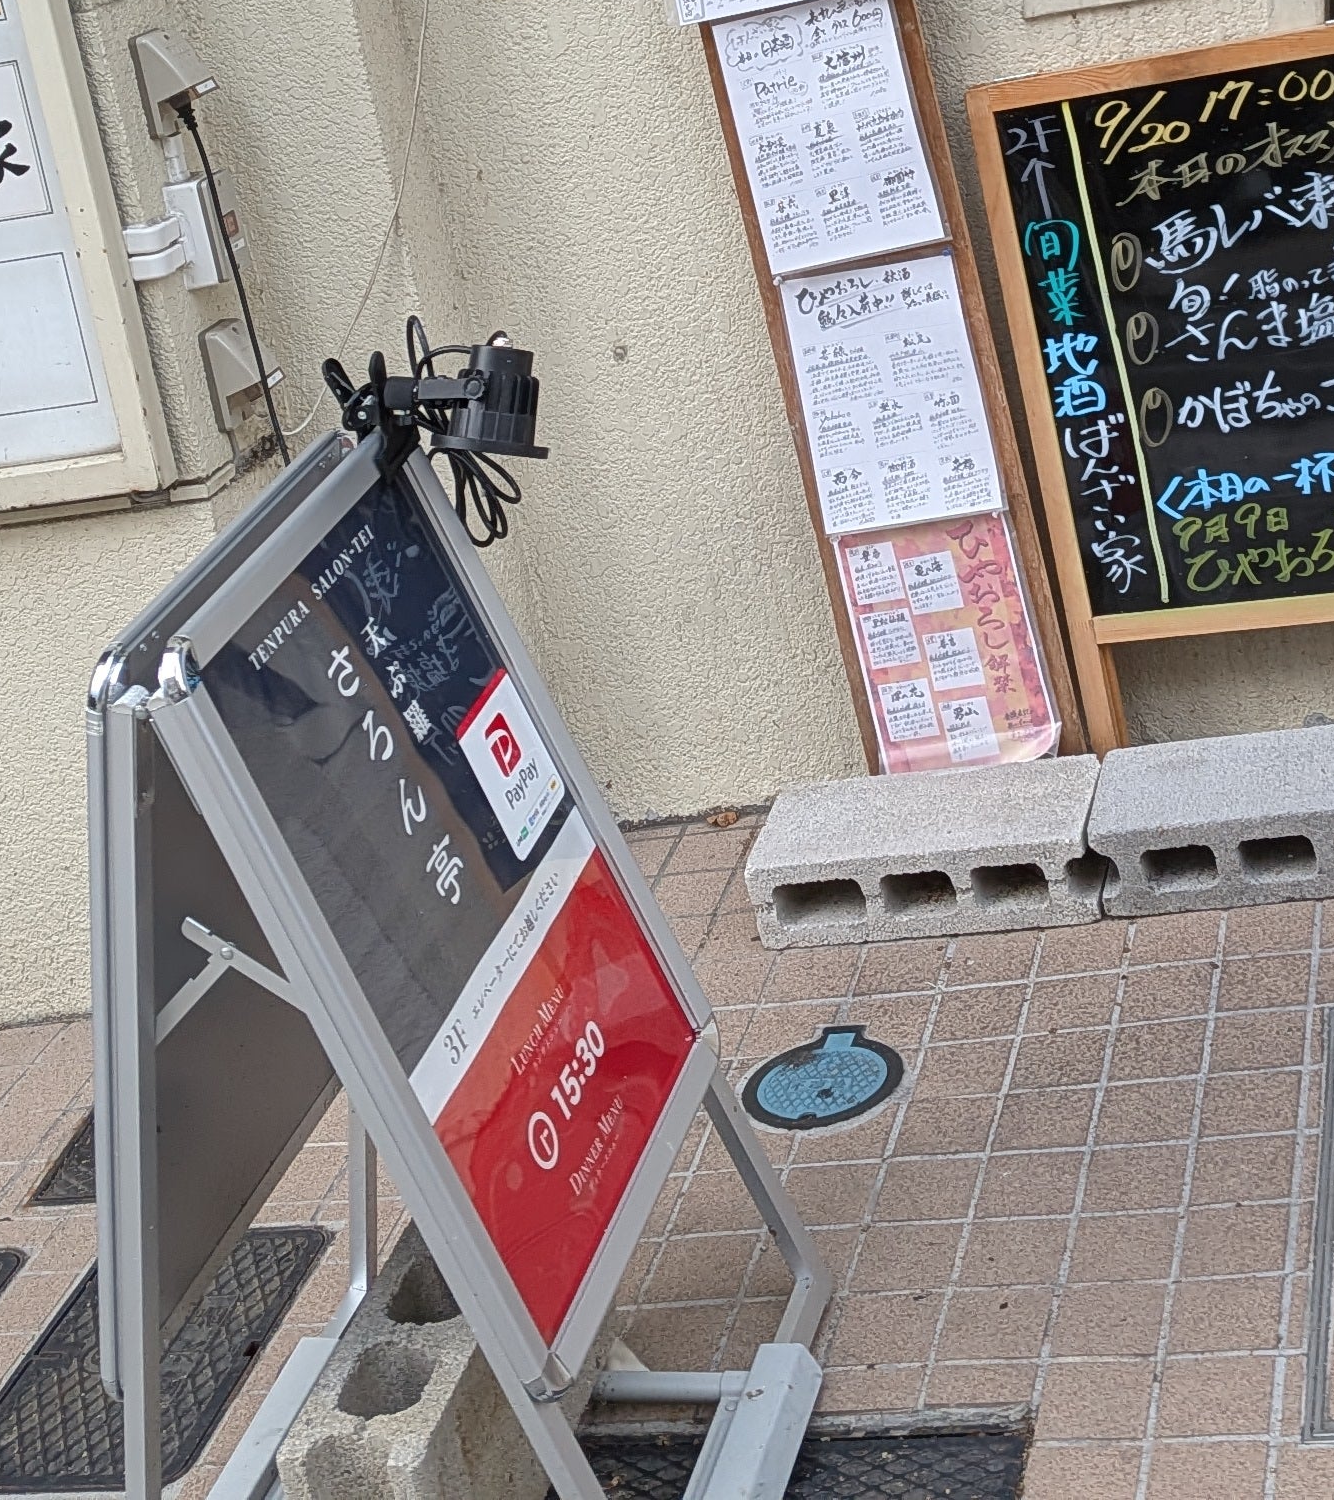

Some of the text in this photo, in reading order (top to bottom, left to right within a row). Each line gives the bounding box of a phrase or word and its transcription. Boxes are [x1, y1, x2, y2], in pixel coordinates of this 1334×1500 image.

[1005, 116, 1062, 157] 2F
[1094, 90, 1191, 165] 9/20
[1044, 333, 1107, 419] 地酒
[1064, 413, 1147, 594] ばんざい家
[1172, 503, 1289, 552] 9月9日
[248, 600, 310, 672] TENPURA
[328, 646, 464, 904] さろん亭
[505, 757, 540, 811] PayPay
[442, 1018, 470, 1066] 3F
[550, 1020, 606, 1121] 15:30
